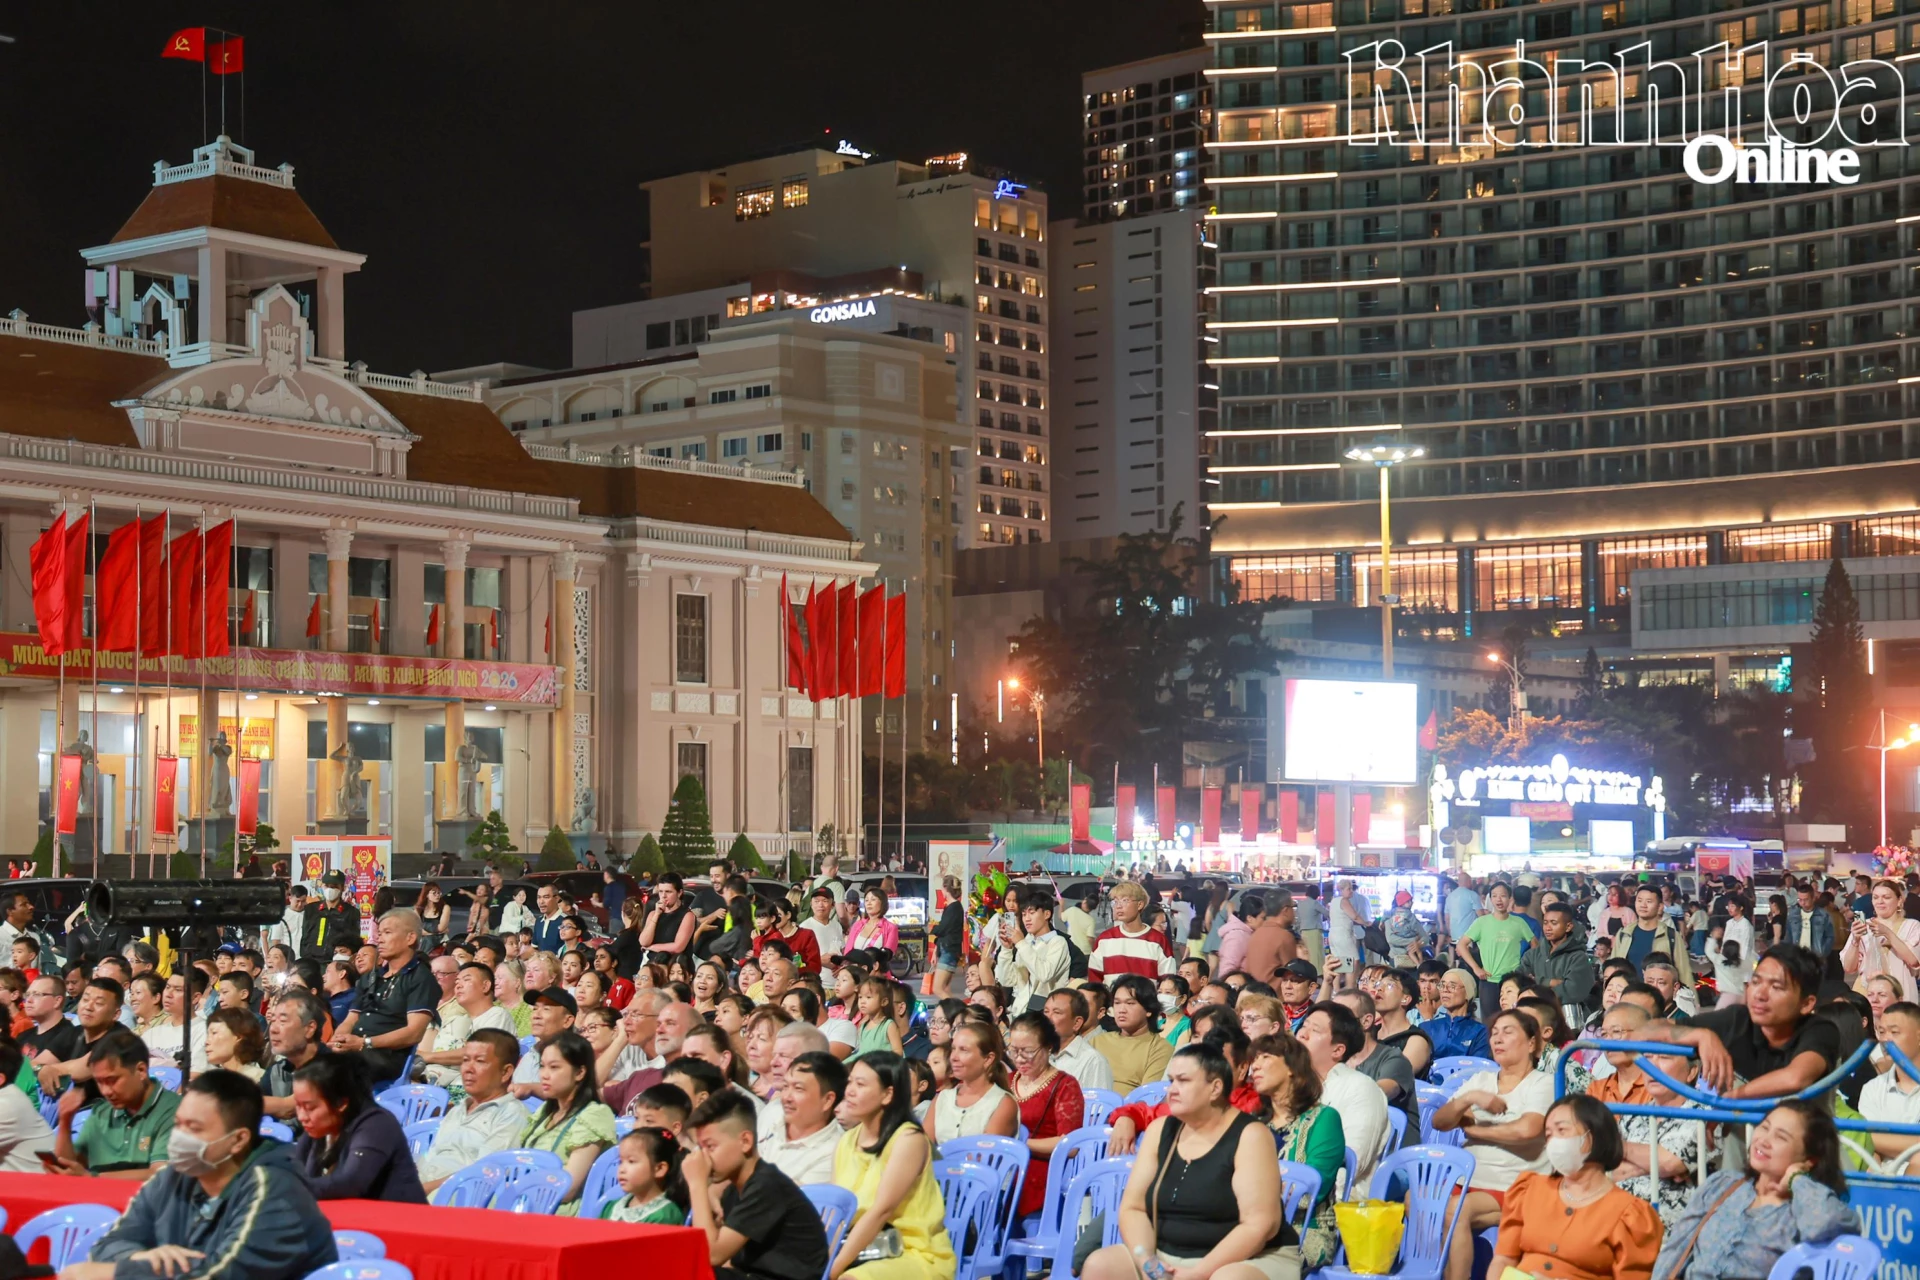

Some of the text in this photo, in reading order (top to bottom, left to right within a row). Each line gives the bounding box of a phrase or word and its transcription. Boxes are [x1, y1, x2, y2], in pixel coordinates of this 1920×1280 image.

[811, 300, 876, 323] GONSALA
[393, 664, 425, 685] XUÂN
[481, 669, 518, 689] 2026
[1855, 1203, 1914, 1249] VỰC
